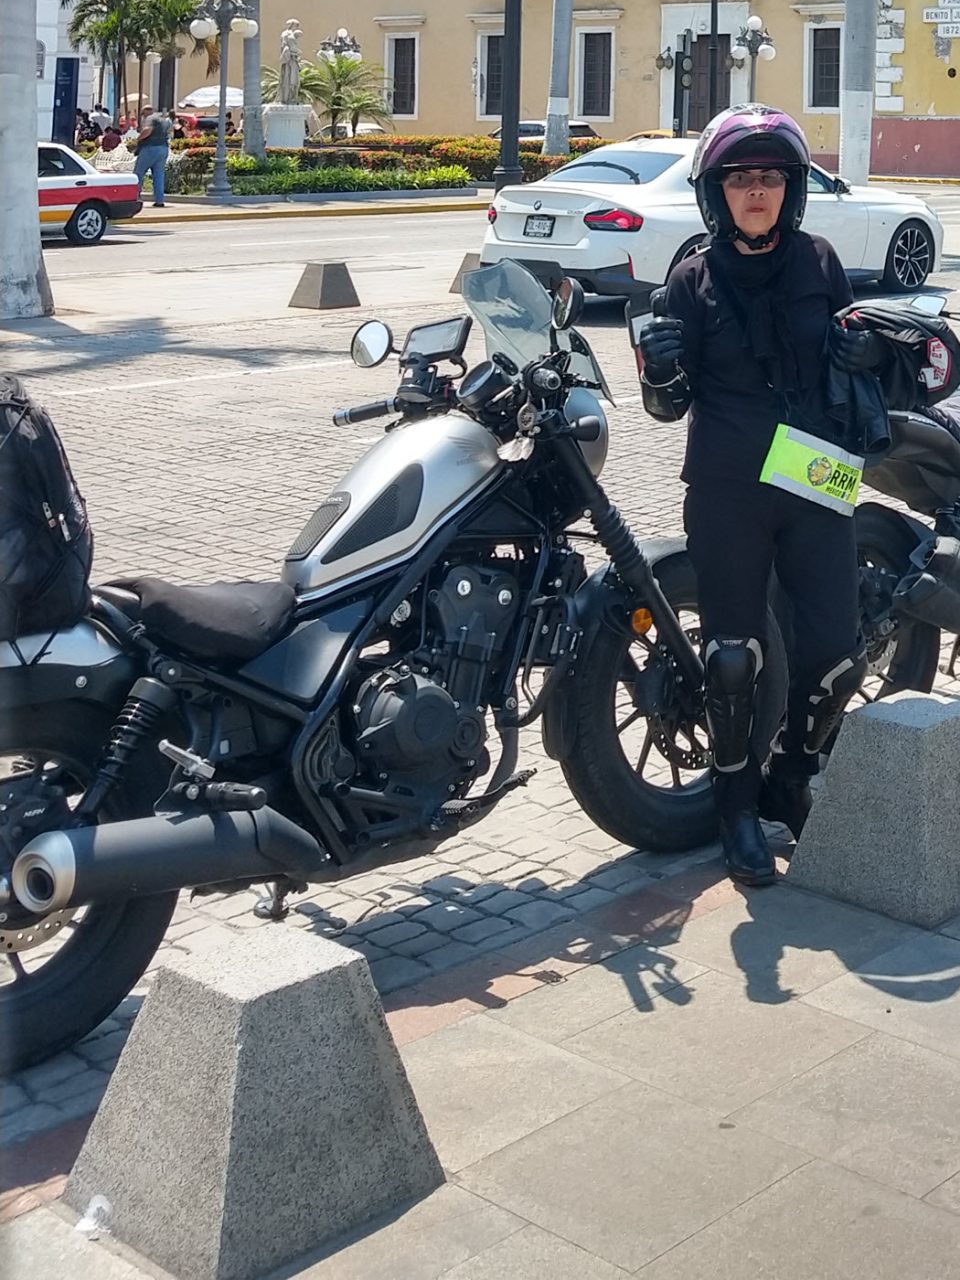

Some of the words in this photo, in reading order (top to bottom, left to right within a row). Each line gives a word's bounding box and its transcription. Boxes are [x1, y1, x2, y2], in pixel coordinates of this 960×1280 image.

[925, 11, 949, 20] BENITO
[943, 26, 960, 34] 1872
[829, 469, 857, 493] RRM
